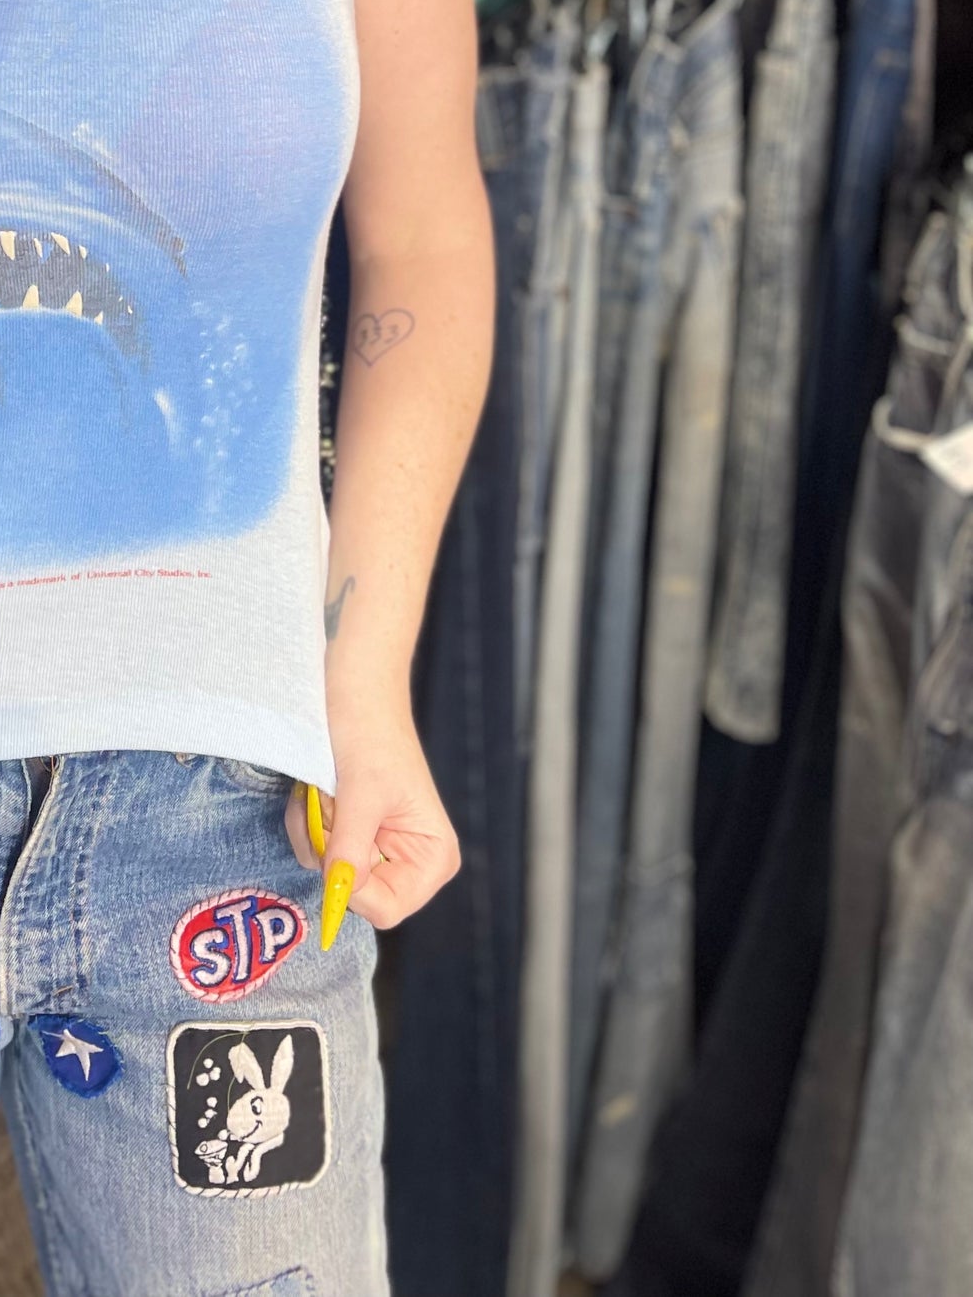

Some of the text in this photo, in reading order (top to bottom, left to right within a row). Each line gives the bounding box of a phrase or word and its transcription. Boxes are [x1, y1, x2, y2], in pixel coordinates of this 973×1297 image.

[16, 573, 67, 587] trademark
[70, 572, 82, 581] of
[86, 568, 132, 580] Universal
[134, 568, 155, 578] City
[189, 894, 298, 988] STP
